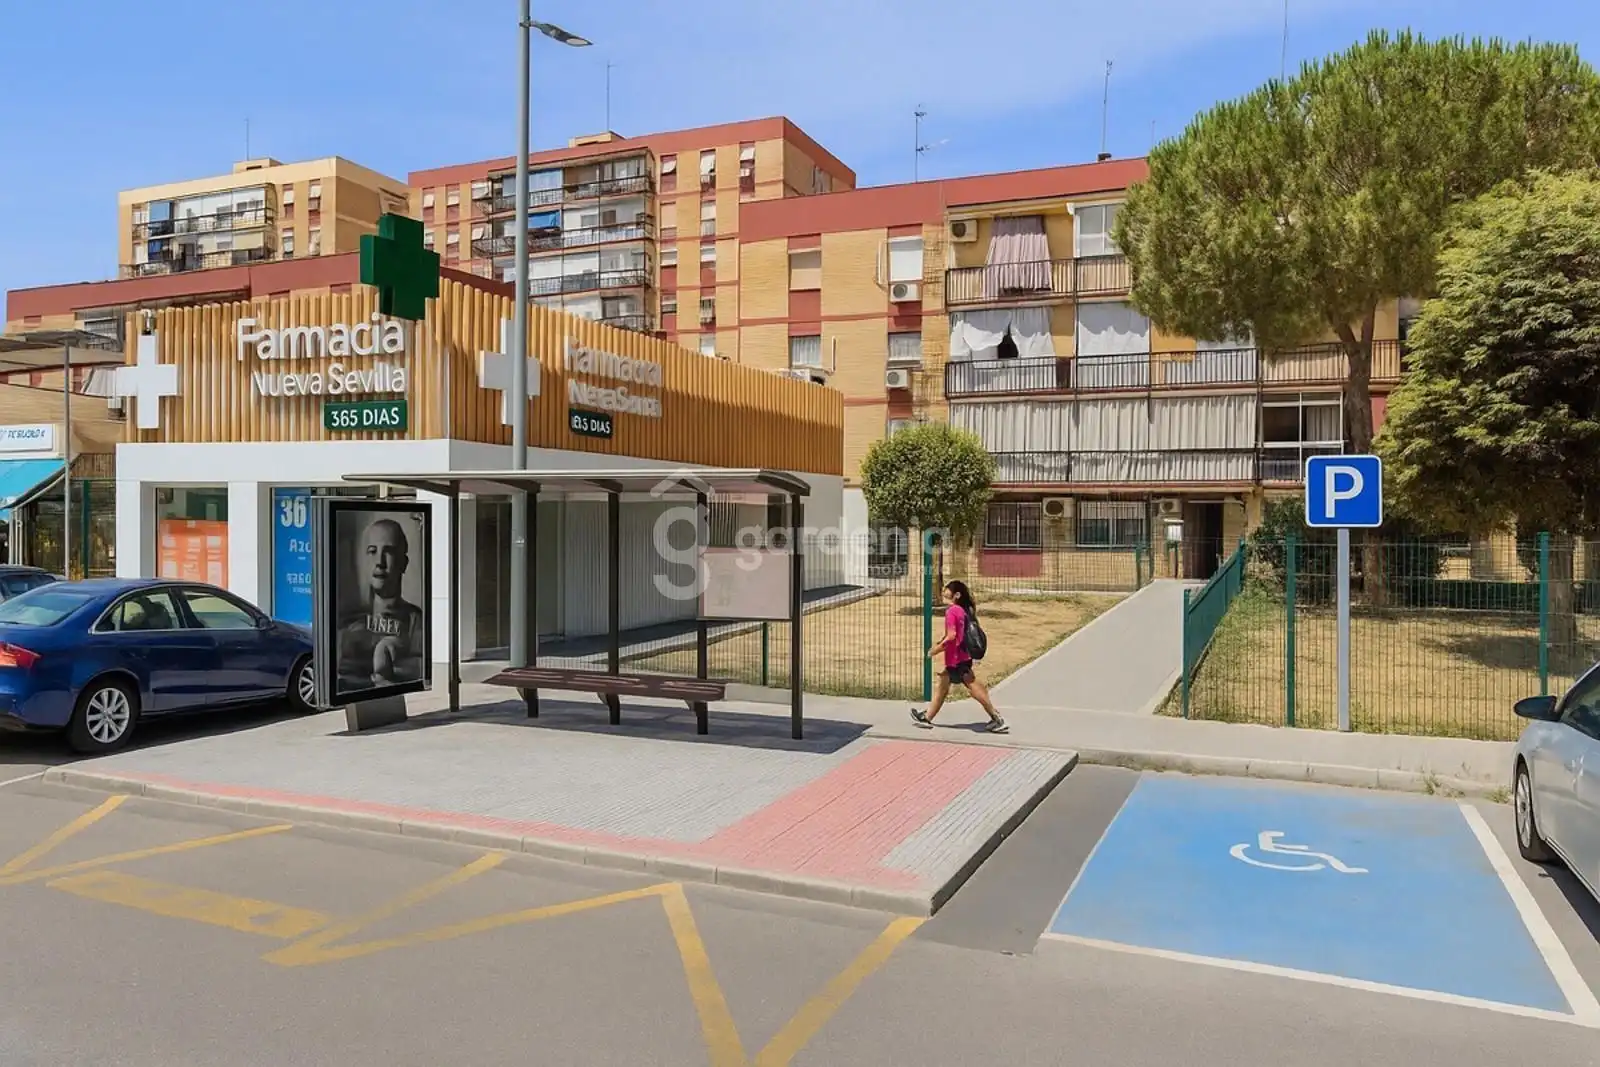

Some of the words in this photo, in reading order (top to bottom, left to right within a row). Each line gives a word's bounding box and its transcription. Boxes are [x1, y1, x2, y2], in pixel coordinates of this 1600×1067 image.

[238, 312, 404, 361] Farmacia
[251, 369, 322, 396] Nueva
[328, 361, 405, 396] Sevilla
[331, 409, 358, 427] 365
[363, 407, 400, 426] DIAS
[1325, 465, 1364, 518] P
